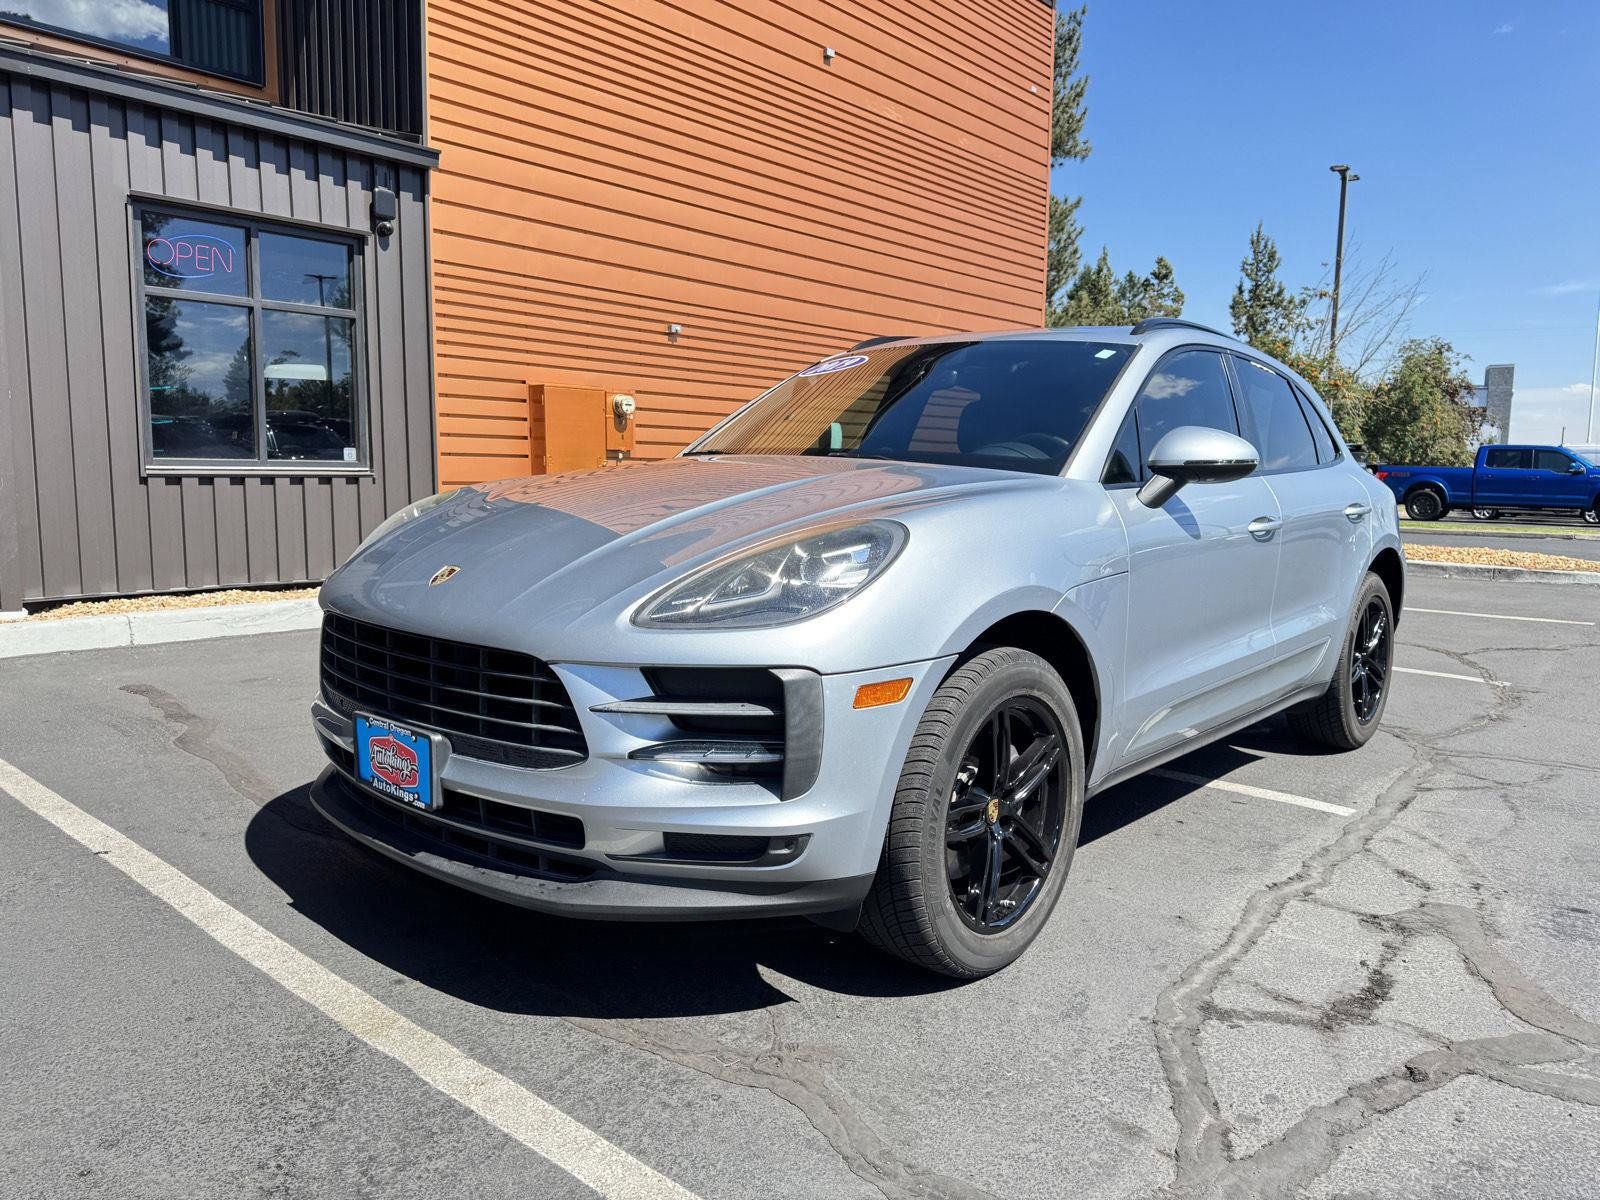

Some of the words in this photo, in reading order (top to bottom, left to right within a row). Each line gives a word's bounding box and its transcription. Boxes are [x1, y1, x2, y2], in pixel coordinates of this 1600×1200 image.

[148, 238, 233, 273] OPEN
[368, 717, 389, 730] Central
[389, 723, 412, 737] Oregon
